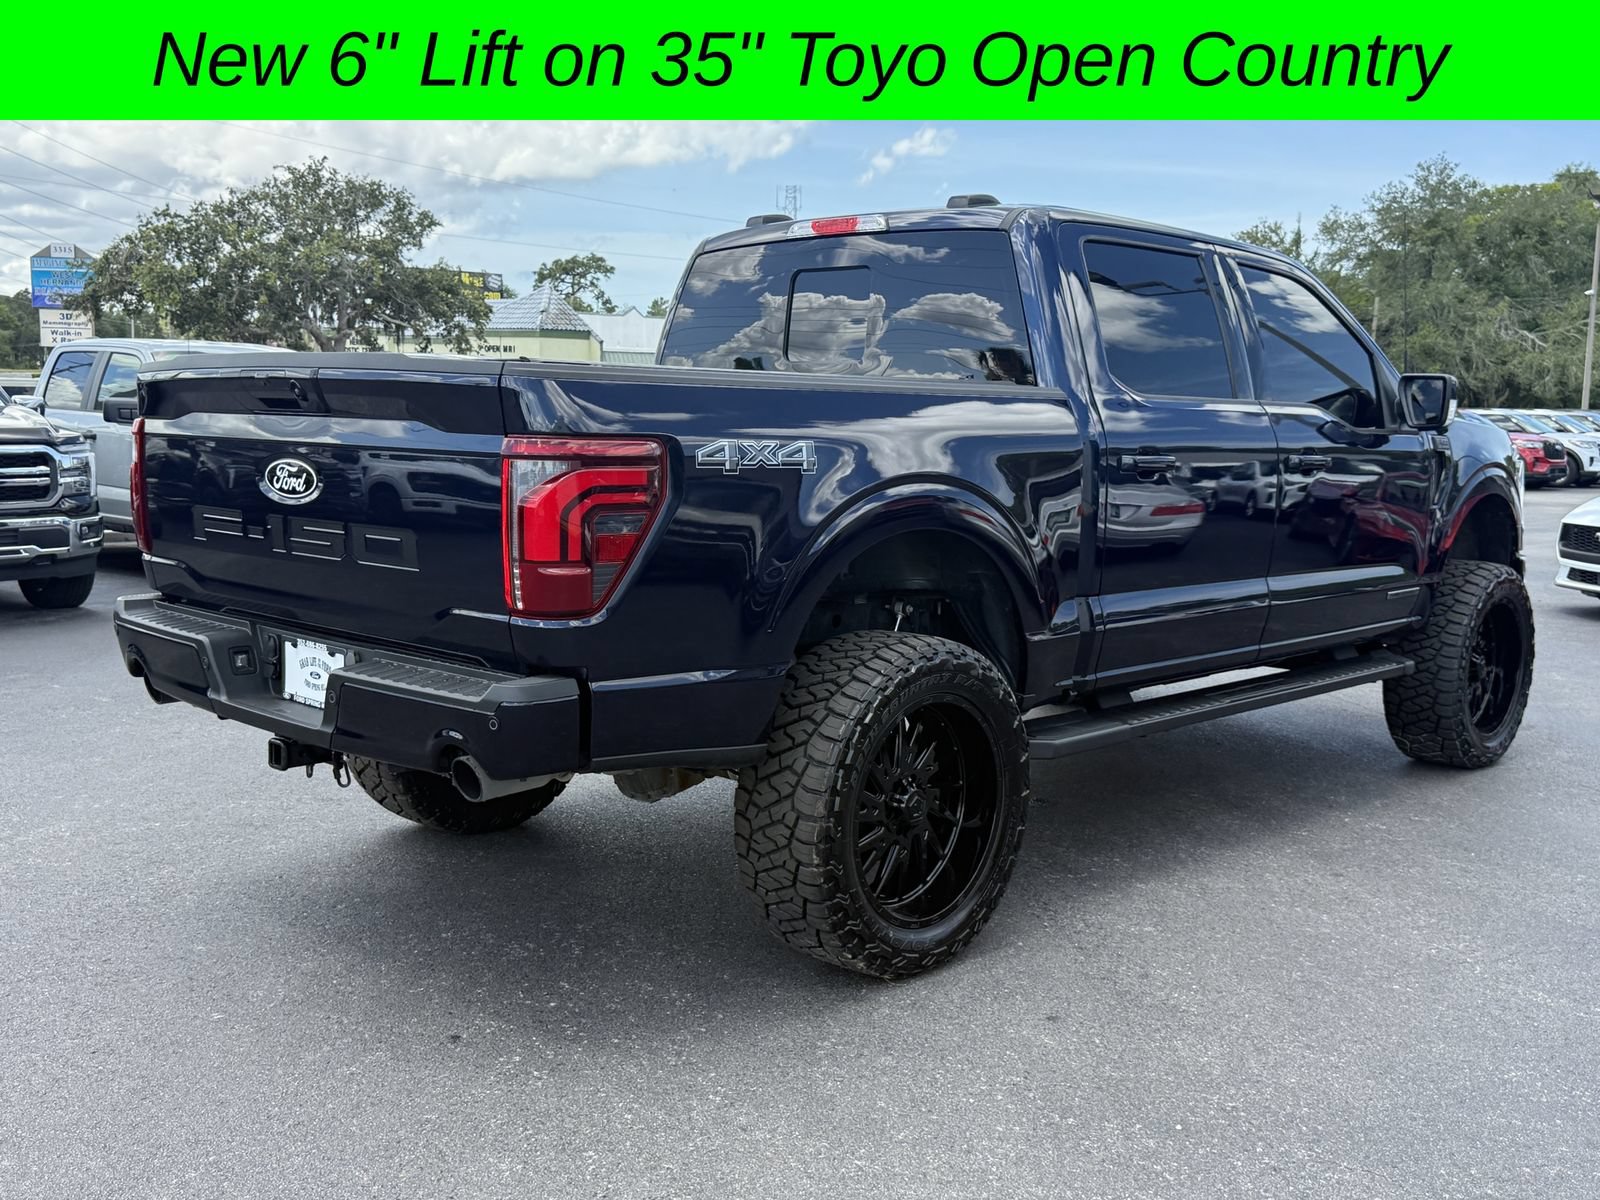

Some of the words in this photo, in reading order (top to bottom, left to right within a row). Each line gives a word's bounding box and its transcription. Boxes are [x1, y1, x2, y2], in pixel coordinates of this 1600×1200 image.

[52, 246, 73, 254] 3315
[59, 312, 73, 320] 3D
[50, 329, 82, 337] Walk-in
[484, 345, 501, 353] OPEN
[502, 345, 516, 353] MRI
[273, 464, 307, 492] Ford
[192, 504, 420, 572] F-150
